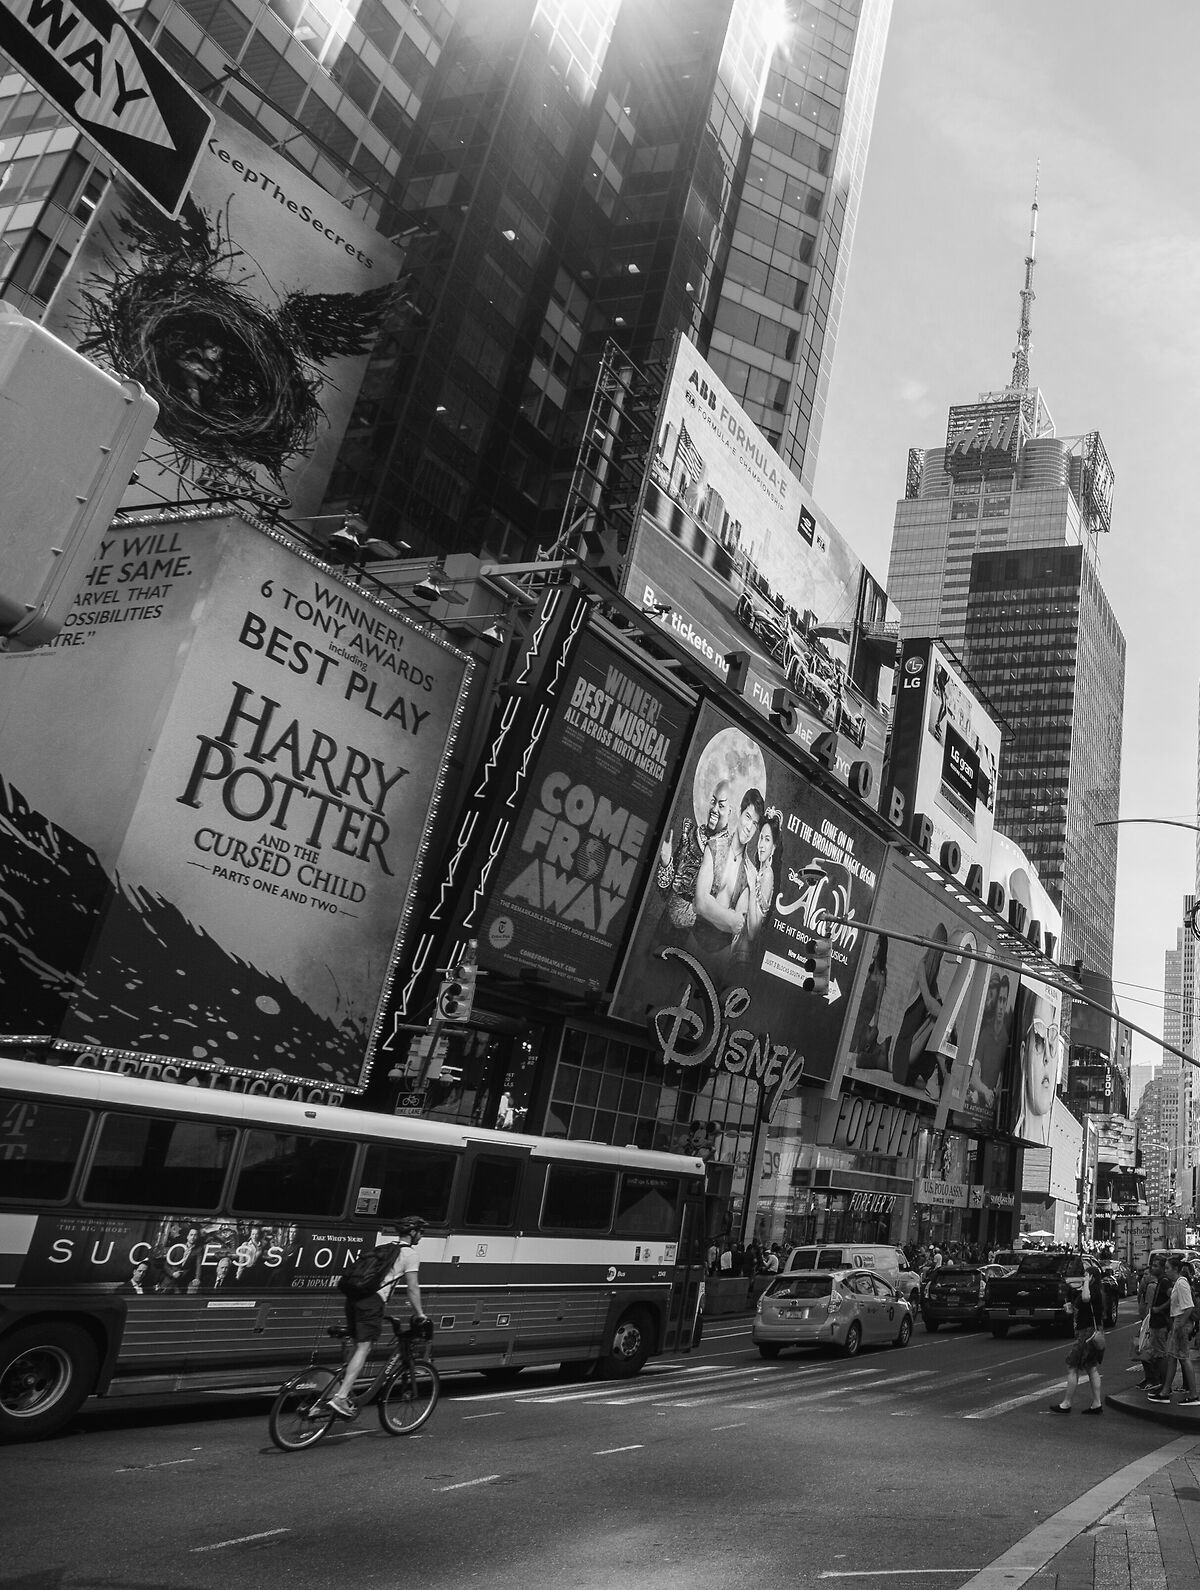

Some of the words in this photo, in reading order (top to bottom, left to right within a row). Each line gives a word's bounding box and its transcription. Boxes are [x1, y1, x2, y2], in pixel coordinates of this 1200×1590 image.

[25, 0, 150, 117] WAY
[688, 369, 717, 411] ABB
[951, 413, 1018, 455] H&M
[739, 456, 784, 511] CHAMPIONSHIP
[119, 556, 193, 582] SAME.
[123, 532, 182, 557] WILL
[127, 583, 172, 601] THAT
[313, 580, 405, 653] WINNER!
[260, 579, 274, 600] 6
[282, 589, 346, 639] TONY
[348, 632, 436, 694] AWARDS
[328, 641, 369, 673] including
[671, 611, 714, 660] tickets
[238, 611, 339, 687] BEST
[344, 671, 431, 736] PLAY
[605, 664, 664, 726] WINNER!
[904, 678, 921, 688] LG
[563, 707, 580, 729] ALL
[580, 716, 613, 746] ACROSS
[611, 738, 635, 762] NORTH
[633, 751, 666, 782] AMERICA
[570, 676, 615, 725] BEST
[610, 705, 671, 766] MUSICAL
[214, 680, 410, 818] HARRY
[950, 745, 960, 763] LG
[176, 733, 396, 877] POTTER
[541, 771, 649, 858] COME
[723, 651, 873, 799] 1540
[888, 786, 1057, 960] BROADWAY
[258, 833, 293, 854] AND
[294, 843, 321, 864] THE
[521, 808, 638, 899] FROM
[787, 813, 801, 835] LET
[800, 820, 812, 842] THE
[811, 827, 845, 866] BROADWAY
[843, 848, 861, 879] MAGIC
[859, 861, 877, 889] BEGIN
[821, 818, 837, 842] COME
[837, 830, 848, 847] ON
[193, 827, 292, 883] CURSED
[297, 863, 367, 904] CHILD
[212, 865, 252, 887] PARTS
[253, 879, 280, 895] ONE
[280, 885, 309, 906] AND
[309, 896, 338, 914] TWO
[504, 857, 626, 935] AWAY
[773, 919, 785, 933] THE
[785, 924, 796, 938] HIT
[831, 948, 848, 965] USICAL
[832, 1093, 920, 1159] FOREVER
[849, 1191, 886, 1213] FOREVER
[924, 1181, 934, 1193] U.S.
[934, 1183, 949, 1195] POLO
[48, 1239, 361, 1268] SUCCESSION
[1124, 1226, 1160, 1236] freshdirect
[291, 1278, 306, 1288] 6/3
[306, 1278, 329, 1288] 10PM
